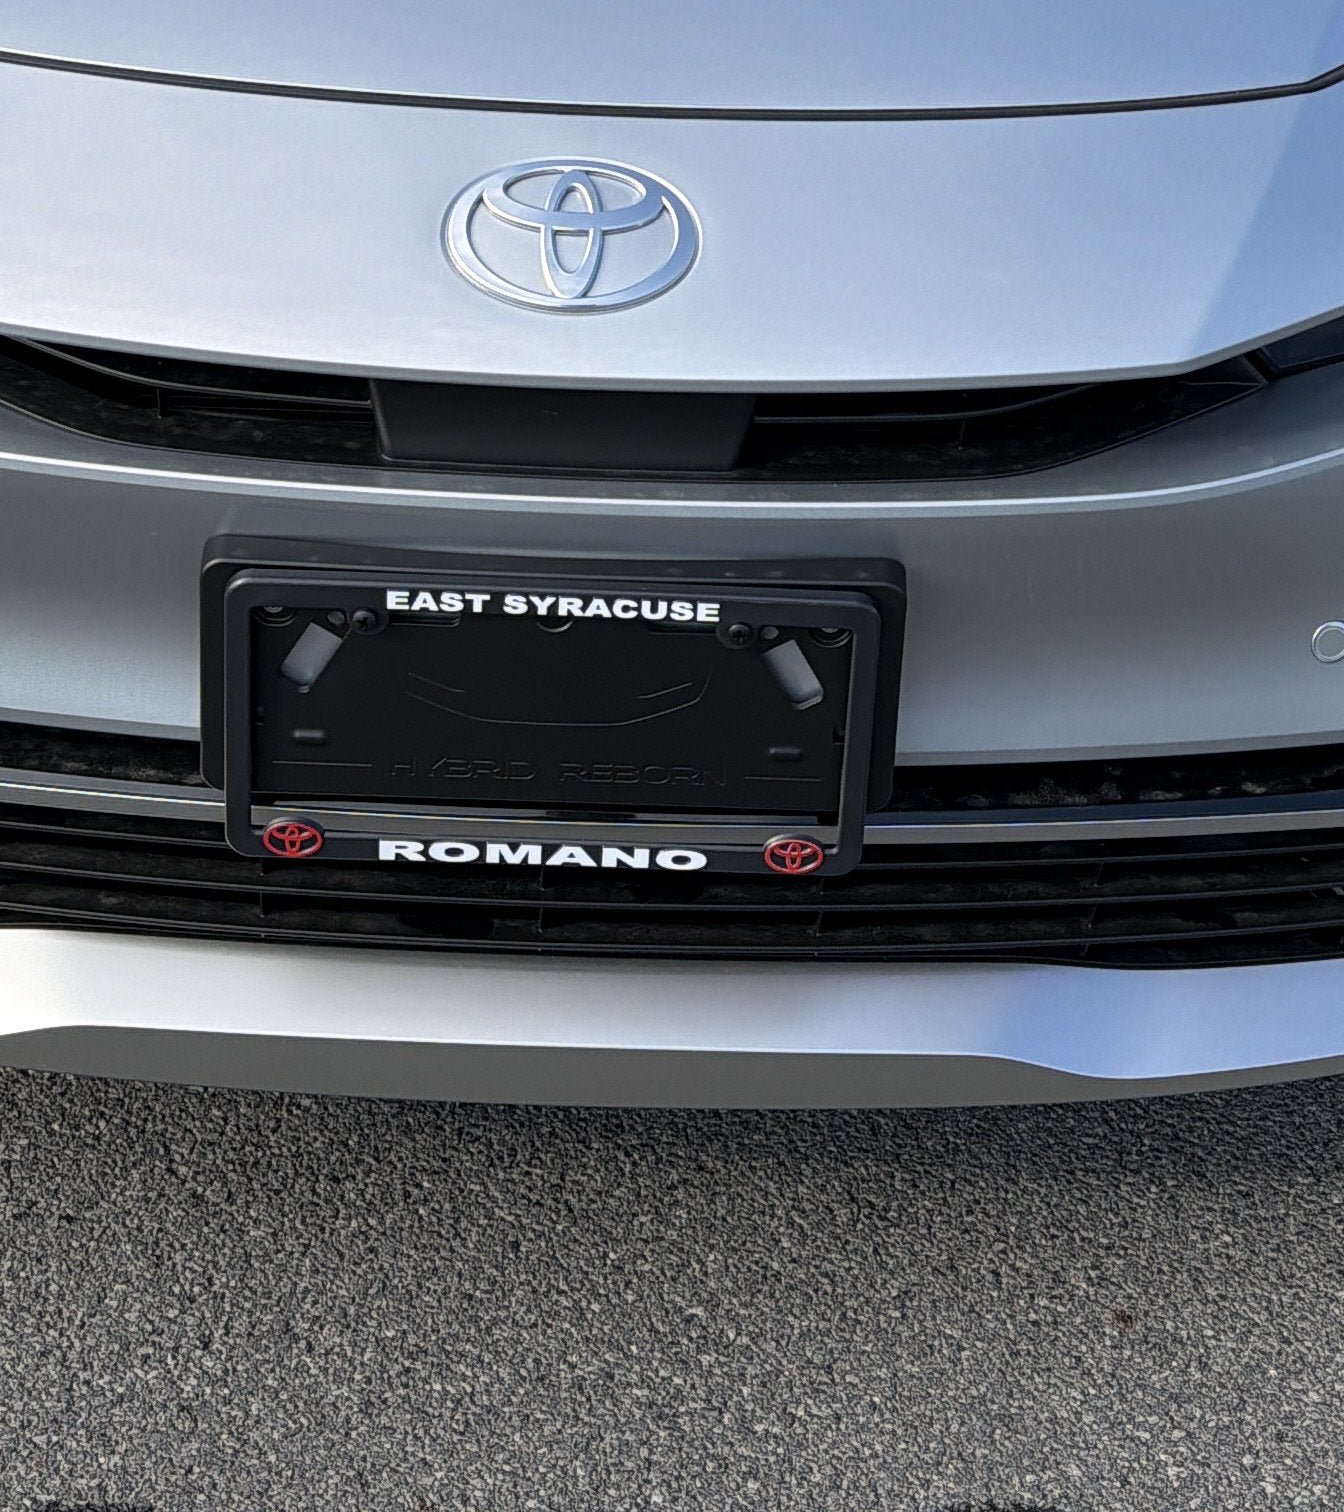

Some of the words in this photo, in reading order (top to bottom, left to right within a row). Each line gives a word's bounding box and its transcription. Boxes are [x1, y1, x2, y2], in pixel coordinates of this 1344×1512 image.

[386, 590, 491, 613] EAST
[503, 594, 721, 622] SYRACUSE
[389, 757, 538, 781] HYBRID
[558, 762, 727, 786] REBORN
[378, 839, 708, 870] ROMANO
